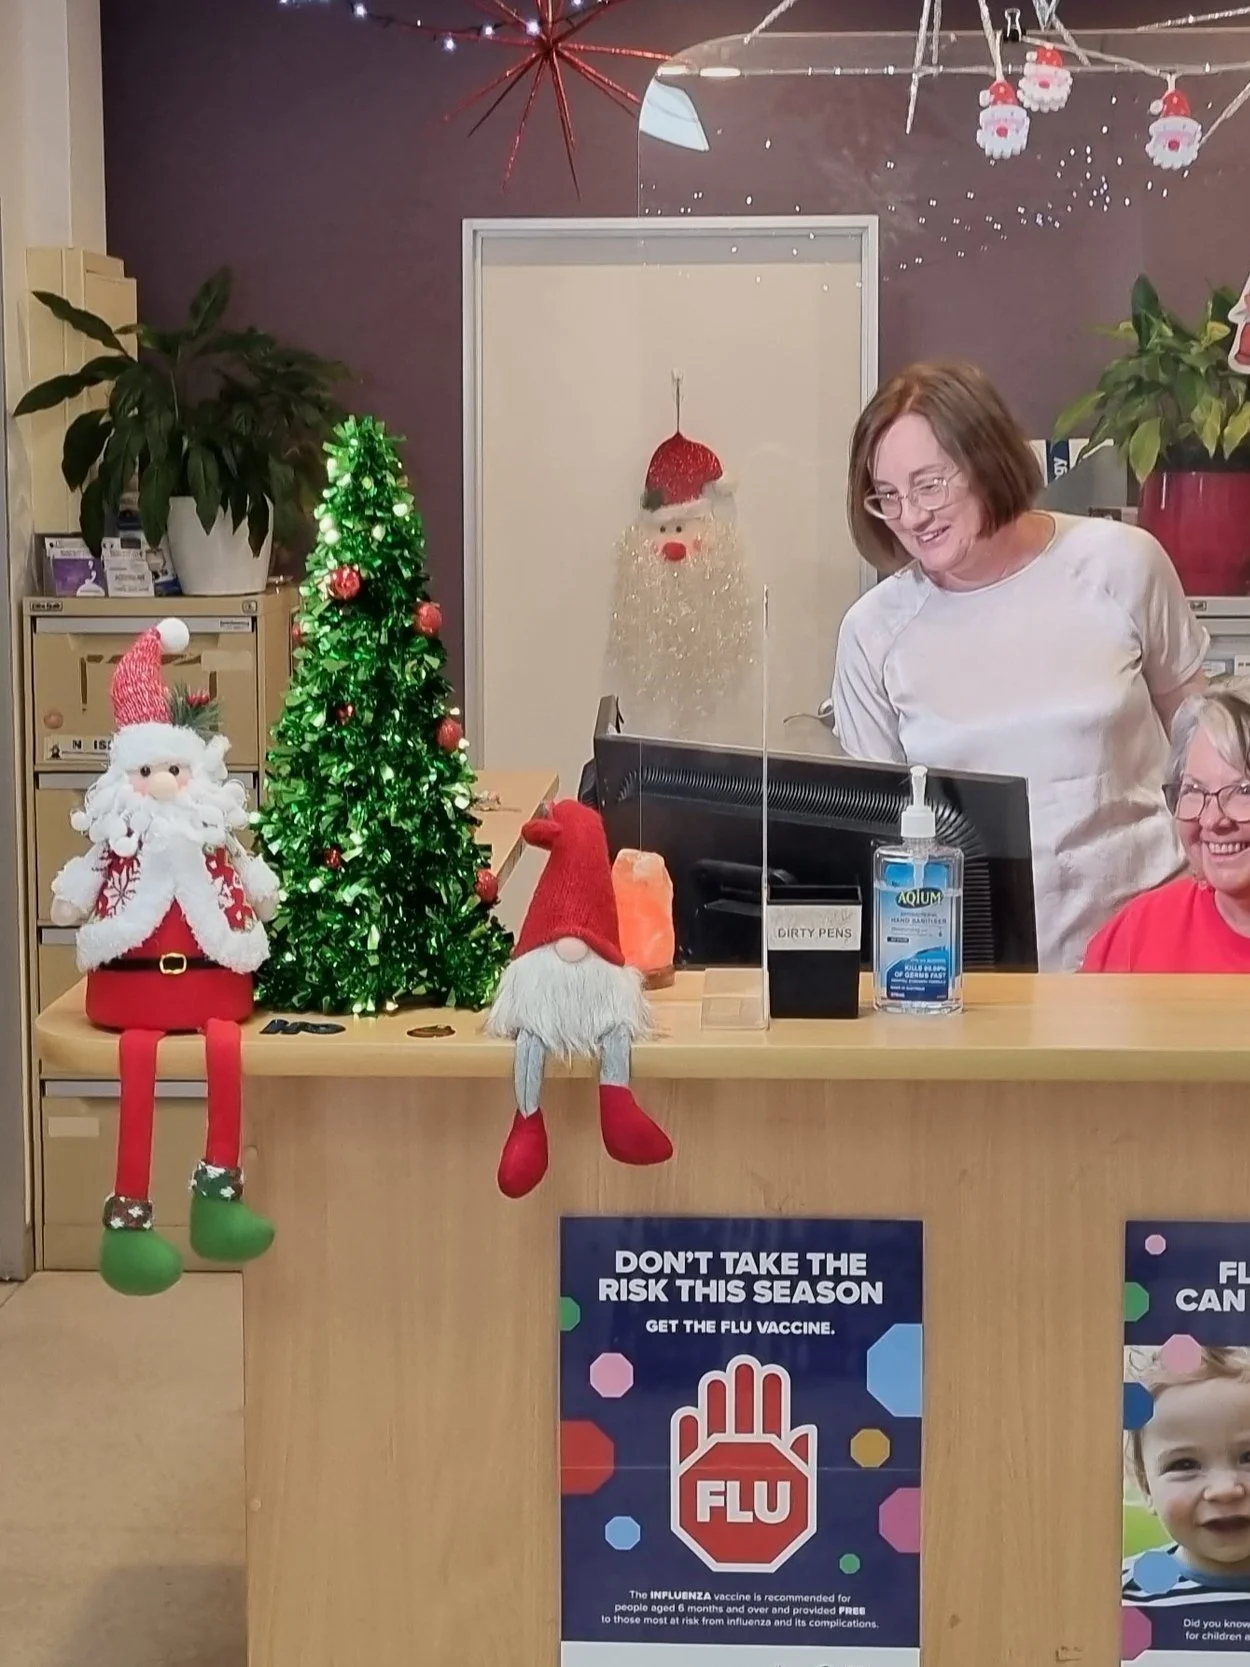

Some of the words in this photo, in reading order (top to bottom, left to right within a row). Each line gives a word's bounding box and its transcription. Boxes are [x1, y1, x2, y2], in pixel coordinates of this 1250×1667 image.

[898, 888, 941, 907] AQIUM
[778, 928, 815, 938] DIRTY
[819, 928, 852, 938] PENS
[615, 1250, 713, 1275] DON’T
[720, 1251, 799, 1275] TAKE
[806, 1252, 867, 1276] THE
[599, 1278, 668, 1302] RISK
[676, 1278, 746, 1303] THIS
[753, 1280, 883, 1304] SEASON
[1175, 1288, 1245, 1312] CAN
[646, 1319, 678, 1333] GET
[683, 1320, 716, 1333] THE
[721, 1320, 752, 1334] FLU
[756, 1320, 836, 1335] VACCINE.
[696, 1480, 791, 1524] FLU
[629, 1590, 648, 1599] The
[650, 1591, 711, 1600] INFLUENZA
[714, 1592, 751, 1602] vaccine
[753, 1592, 761, 1602] is
[764, 1594, 835, 1603] recommended
[838, 1594, 851, 1603] for
[614, 1603, 648, 1613] people
[651, 1603, 675, 1613] aged
[678, 1604, 684, 1613] 6
[687, 1604, 723, 1613] months
[726, 1605, 744, 1614] and
[772, 1605, 790, 1614] and
[793, 1606, 836, 1616] provided
[839, 1606, 865, 1615] FREE
[601, 1615, 610, 1623] to
[613, 1615, 641, 1624] those
[643, 1616, 667, 1624] most
[670, 1616, 680, 1625] at
[682, 1616, 699, 1625] risk
[702, 1616, 724, 1625] from
[727, 1617, 771, 1627] influenza
[774, 1618, 792, 1627] and
[795, 1618, 806, 1627] its
[809, 1618, 880, 1628] complications.
[1183, 1618, 1200, 1627] Did
[1203, 1620, 1221, 1629] you
[1185, 1631, 1199, 1640] for
[1202, 1632, 1241, 1641] children
